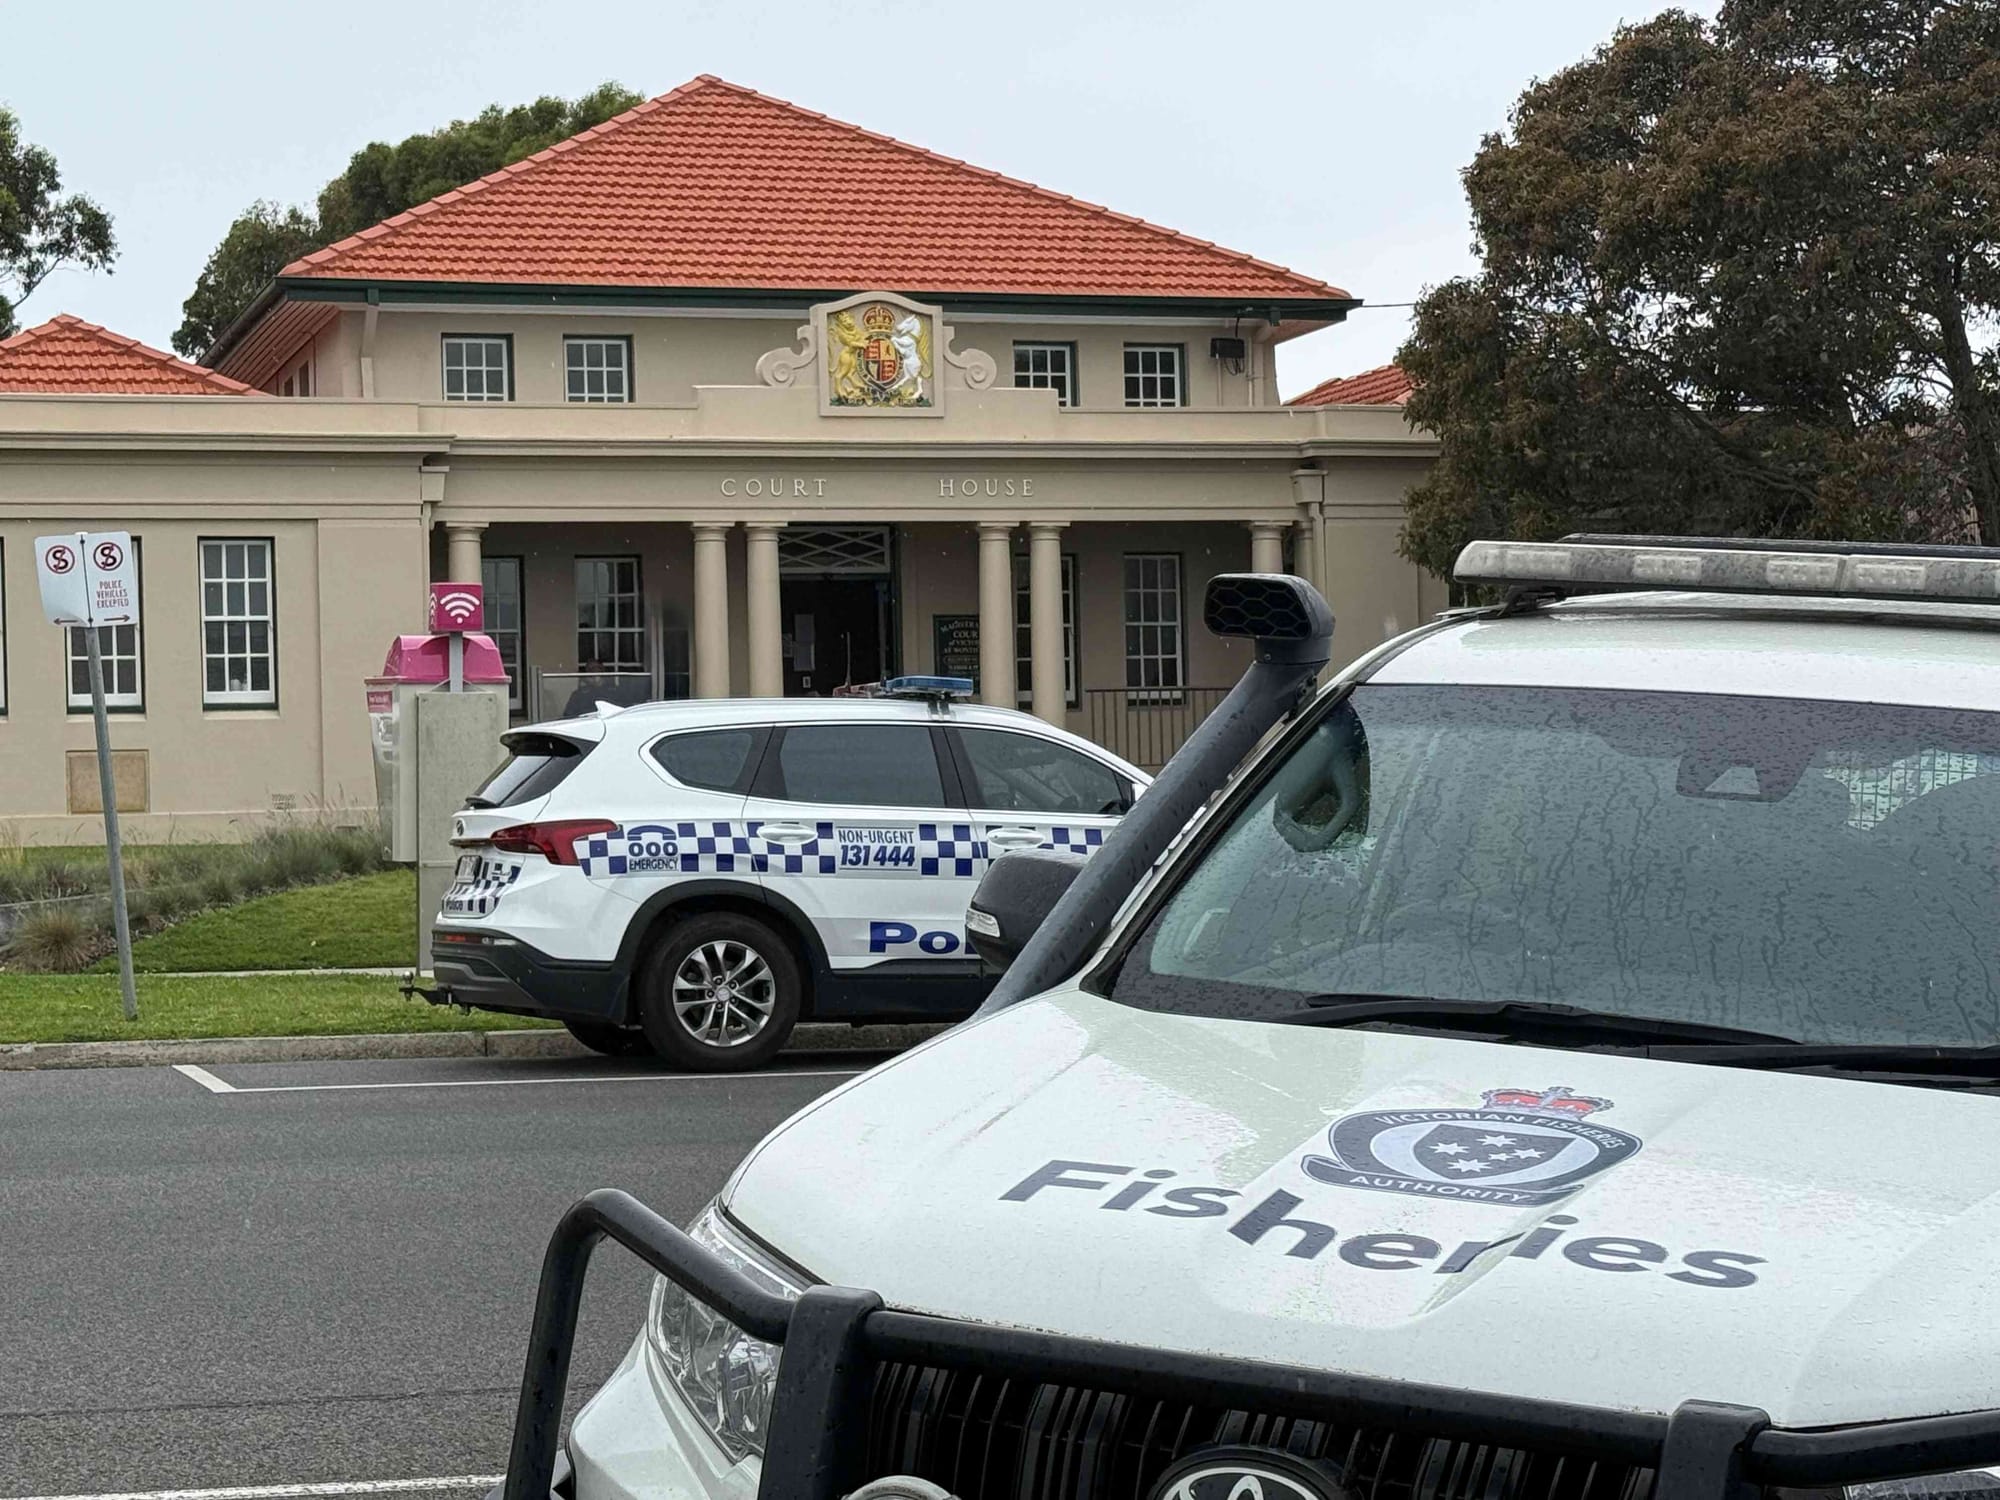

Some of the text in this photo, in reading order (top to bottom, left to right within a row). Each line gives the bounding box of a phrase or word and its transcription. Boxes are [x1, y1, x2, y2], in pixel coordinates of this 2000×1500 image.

[720, 478, 1035, 498] COURT HOUSE
[99, 580, 123, 589] POLICE
[96, 589, 128, 599] VEHICLES
[97, 598, 129, 608] EXCEPTED
[838, 830, 914, 844] NON-URGENT
[629, 858, 678, 870] EMERGENCY
[1374, 1111, 1626, 1150] VICTORIAN FISHERIES
[1350, 1175, 1533, 1203] AUTHORITY
[999, 1159, 1767, 1288] Fisheries
